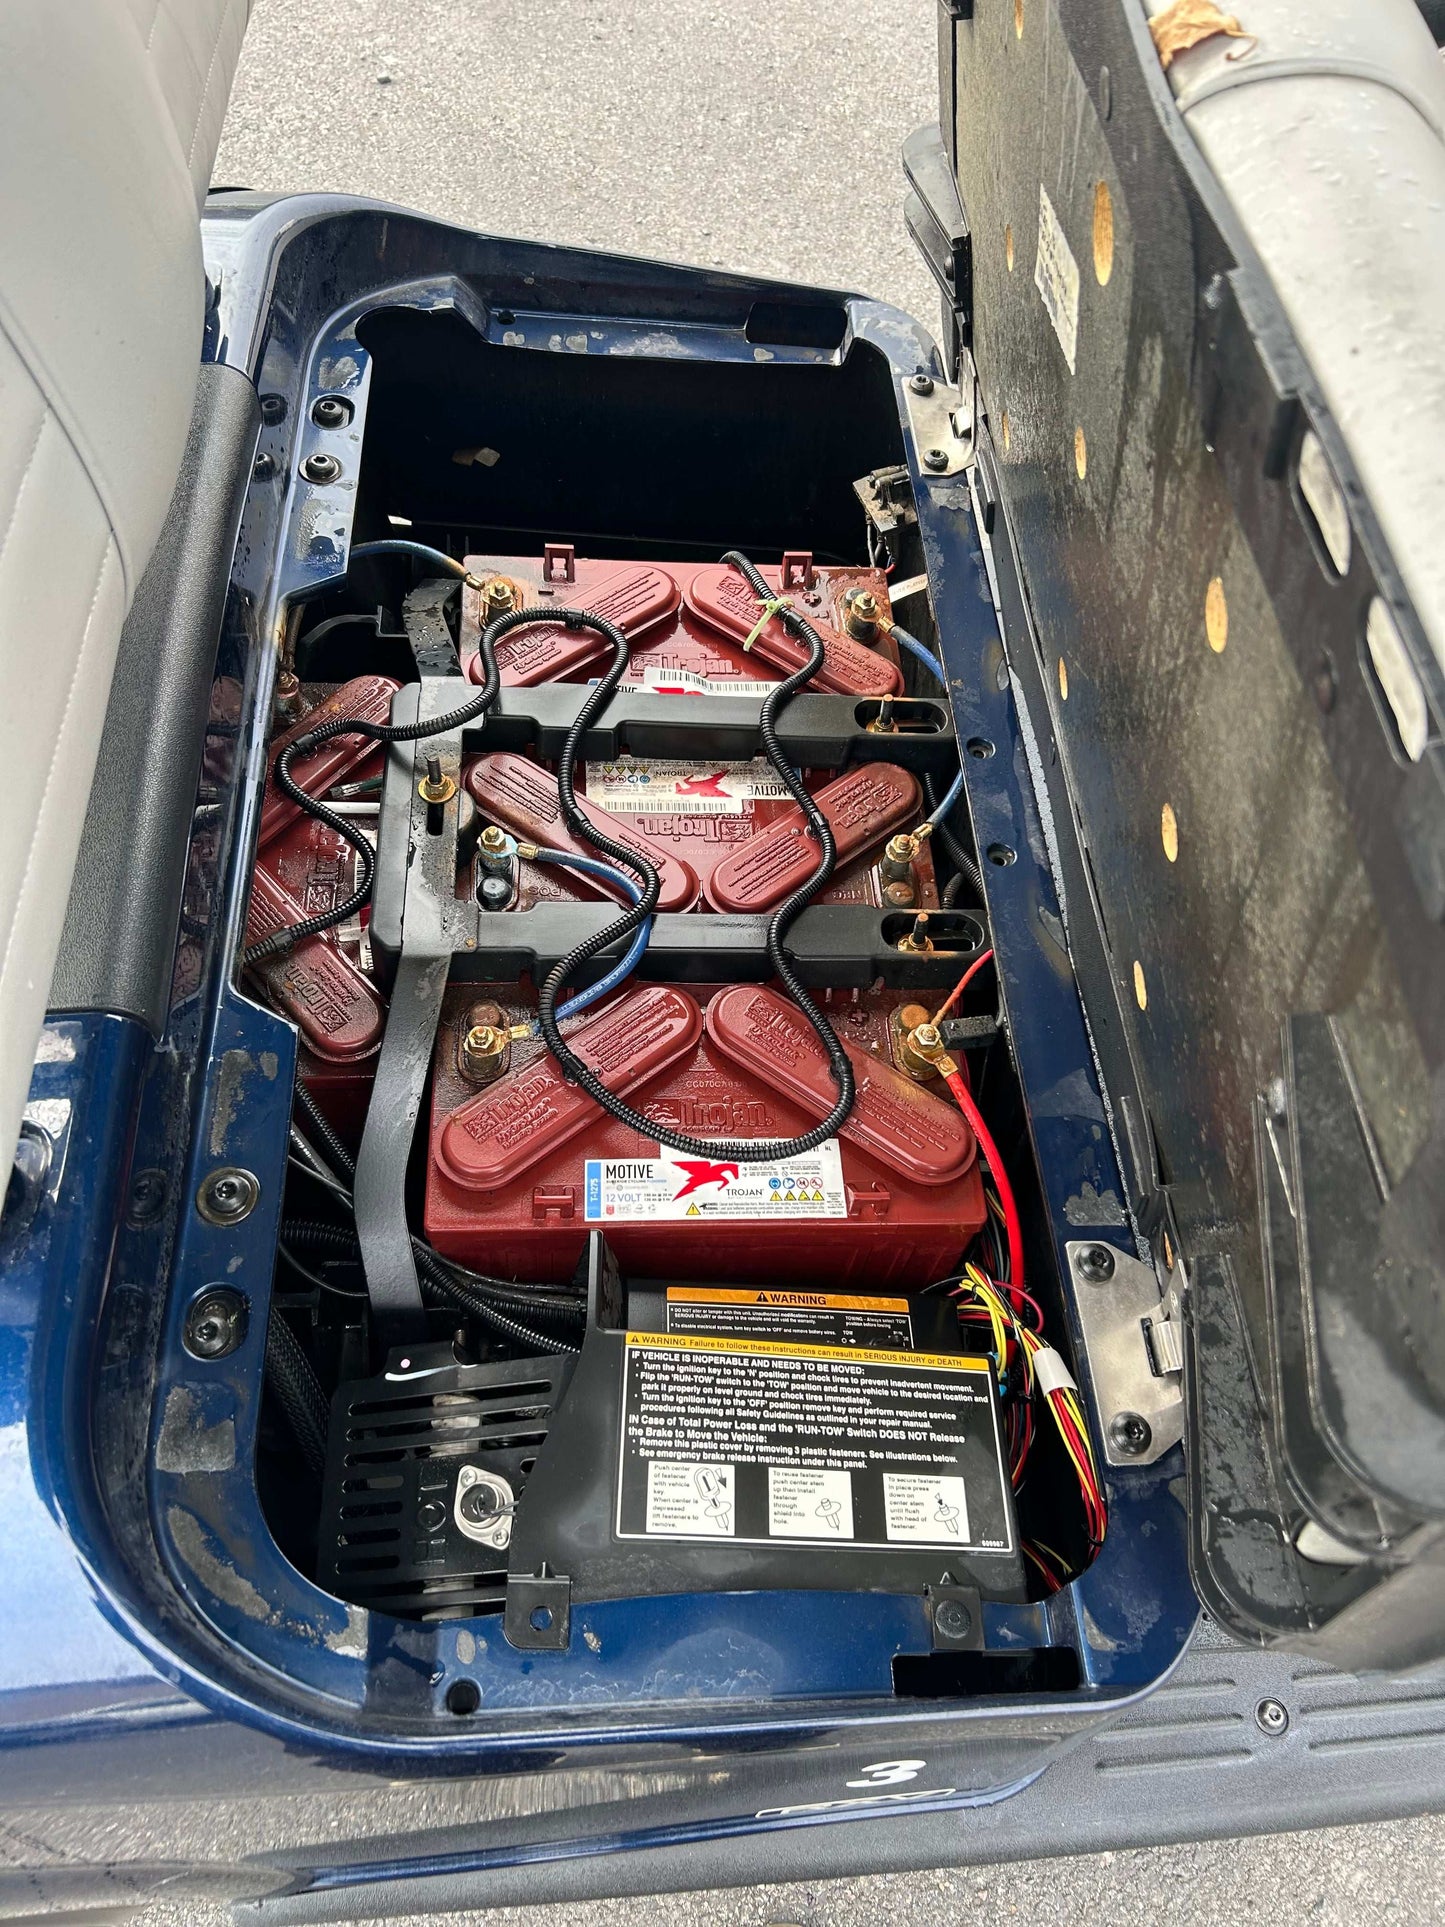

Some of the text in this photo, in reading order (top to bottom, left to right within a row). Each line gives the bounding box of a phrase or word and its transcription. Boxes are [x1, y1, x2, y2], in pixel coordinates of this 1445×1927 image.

[644, 814, 720, 843] Trojan
[680, 1096, 770, 1132] Trojan
[606, 1164, 654, 1179] MOTIVE
[590, 1178, 598, 1202] T-1275
[606, 1193, 642, 1203] 12 VOLT
[726, 1188, 763, 1197] TROJAN
[770, 1293, 827, 1305] WARNING
[632, 1351, 865, 1374] IF VEHICLE IS INOPERABLE AND NEEDS TO BE MOVED:
[642, 1337, 686, 1347] WARNING
[689, 1339, 714, 1348] Failure
[716, 1341, 724, 1349] to
[727, 1342, 749, 1351] follow
[749, 1343, 772, 1352] these
[771, 1345, 815, 1355] instructions
[831, 1350, 854, 1358] result
[855, 1351, 863, 1359] in
[862, 1352, 898, 1362] SERIOUS
[898, 1355, 927, 1364] INJURY
[926, 1357, 936, 1365] or
[936, 1358, 964, 1367] DEATH
[640, 1371, 988, 1403] Flip the 'RUN-TOW' switch to the 'TOW' position and move vehicle to the desired location and
[643, 1361, 974, 1392] Turn the ignition key to the 'N' position and chock tires to prevent inadvertent movement.
[641, 1382, 872, 1406] park it properly on level ground and chock tires immediately.
[642, 1392, 956, 1420] Turn the ignition key to the 'OFF' position remove key and perform required service
[640, 1403, 686, 1415] procedures
[687, 1405, 724, 1417] following
[725, 1408, 735, 1416] all
[736, 1408, 761, 1419] Safety
[763, 1410, 804, 1421] Guidelines
[817, 1413, 848, 1423] outlined
[850, 1415, 858, 1424] in
[859, 1417, 877, 1426] your
[878, 1417, 901, 1428] repair
[902, 1418, 932, 1428] manual.
[628, 1427, 767, 1443] the Brake to Move the Vehicle:
[629, 1414, 965, 1443] IN Case of Total Power Loss and the 'RUN-TOW' Switch DOES NOT Release
[639, 1448, 867, 1470] See emergency brake release instruction under this panel.
[640, 1437, 958, 1463] Remove this plastic cover by removing 3 plastic fasteners. See illustrations below.
[846, 1759, 927, 1788] 3
